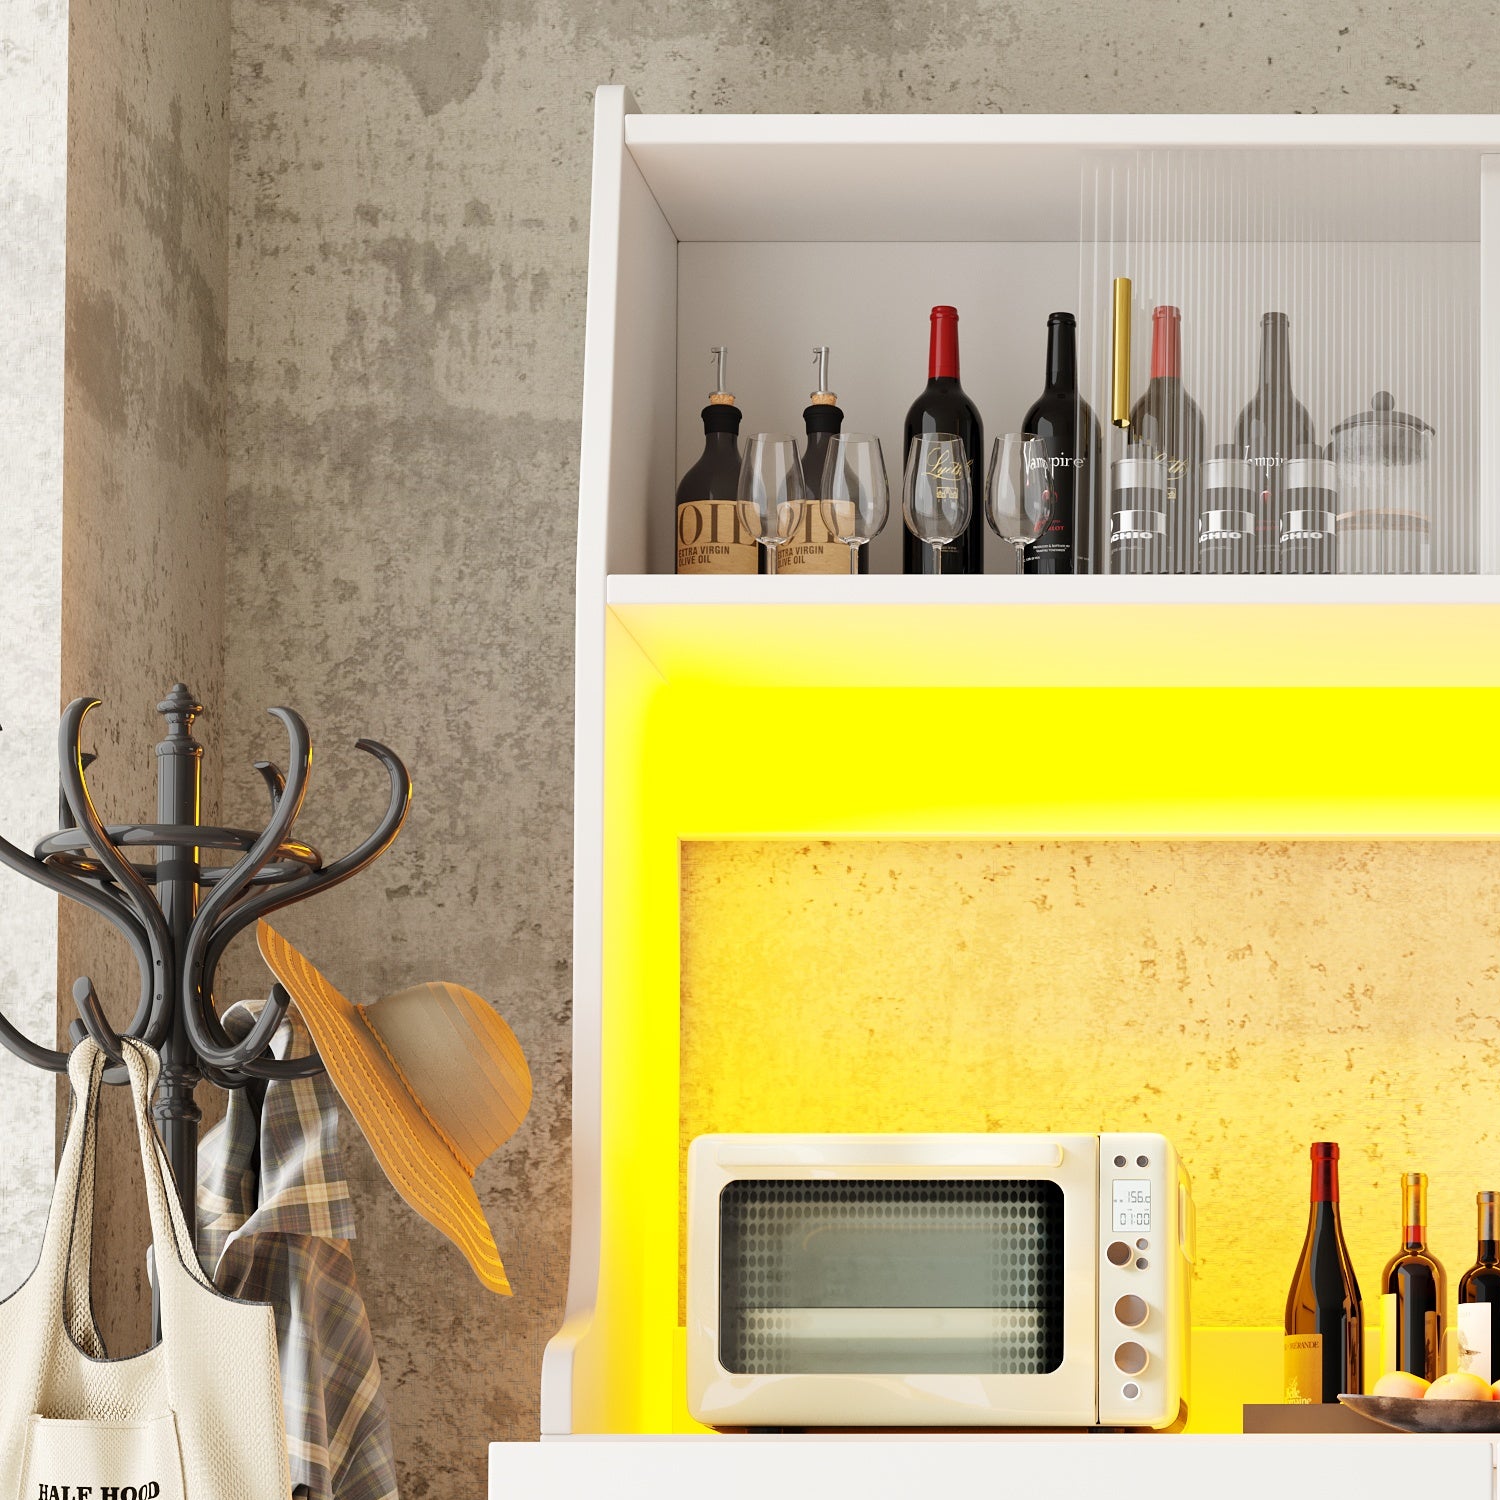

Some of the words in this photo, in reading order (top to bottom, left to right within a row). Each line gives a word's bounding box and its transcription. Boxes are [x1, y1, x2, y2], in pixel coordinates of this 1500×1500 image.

[679, 504, 757, 547] OIL
[1111, 532, 1153, 543] CHIO
[1199, 532, 1241, 543] CHIO
[1280, 532, 1323, 543] CHIO
[678, 547, 698, 558] EXTRA
[700, 546, 730, 554] VIRGIN
[795, 546, 824, 555] VIRGIN
[678, 556, 696, 567] OLIVE
[698, 555, 711, 564] OIL
[793, 555, 806, 564] OIL
